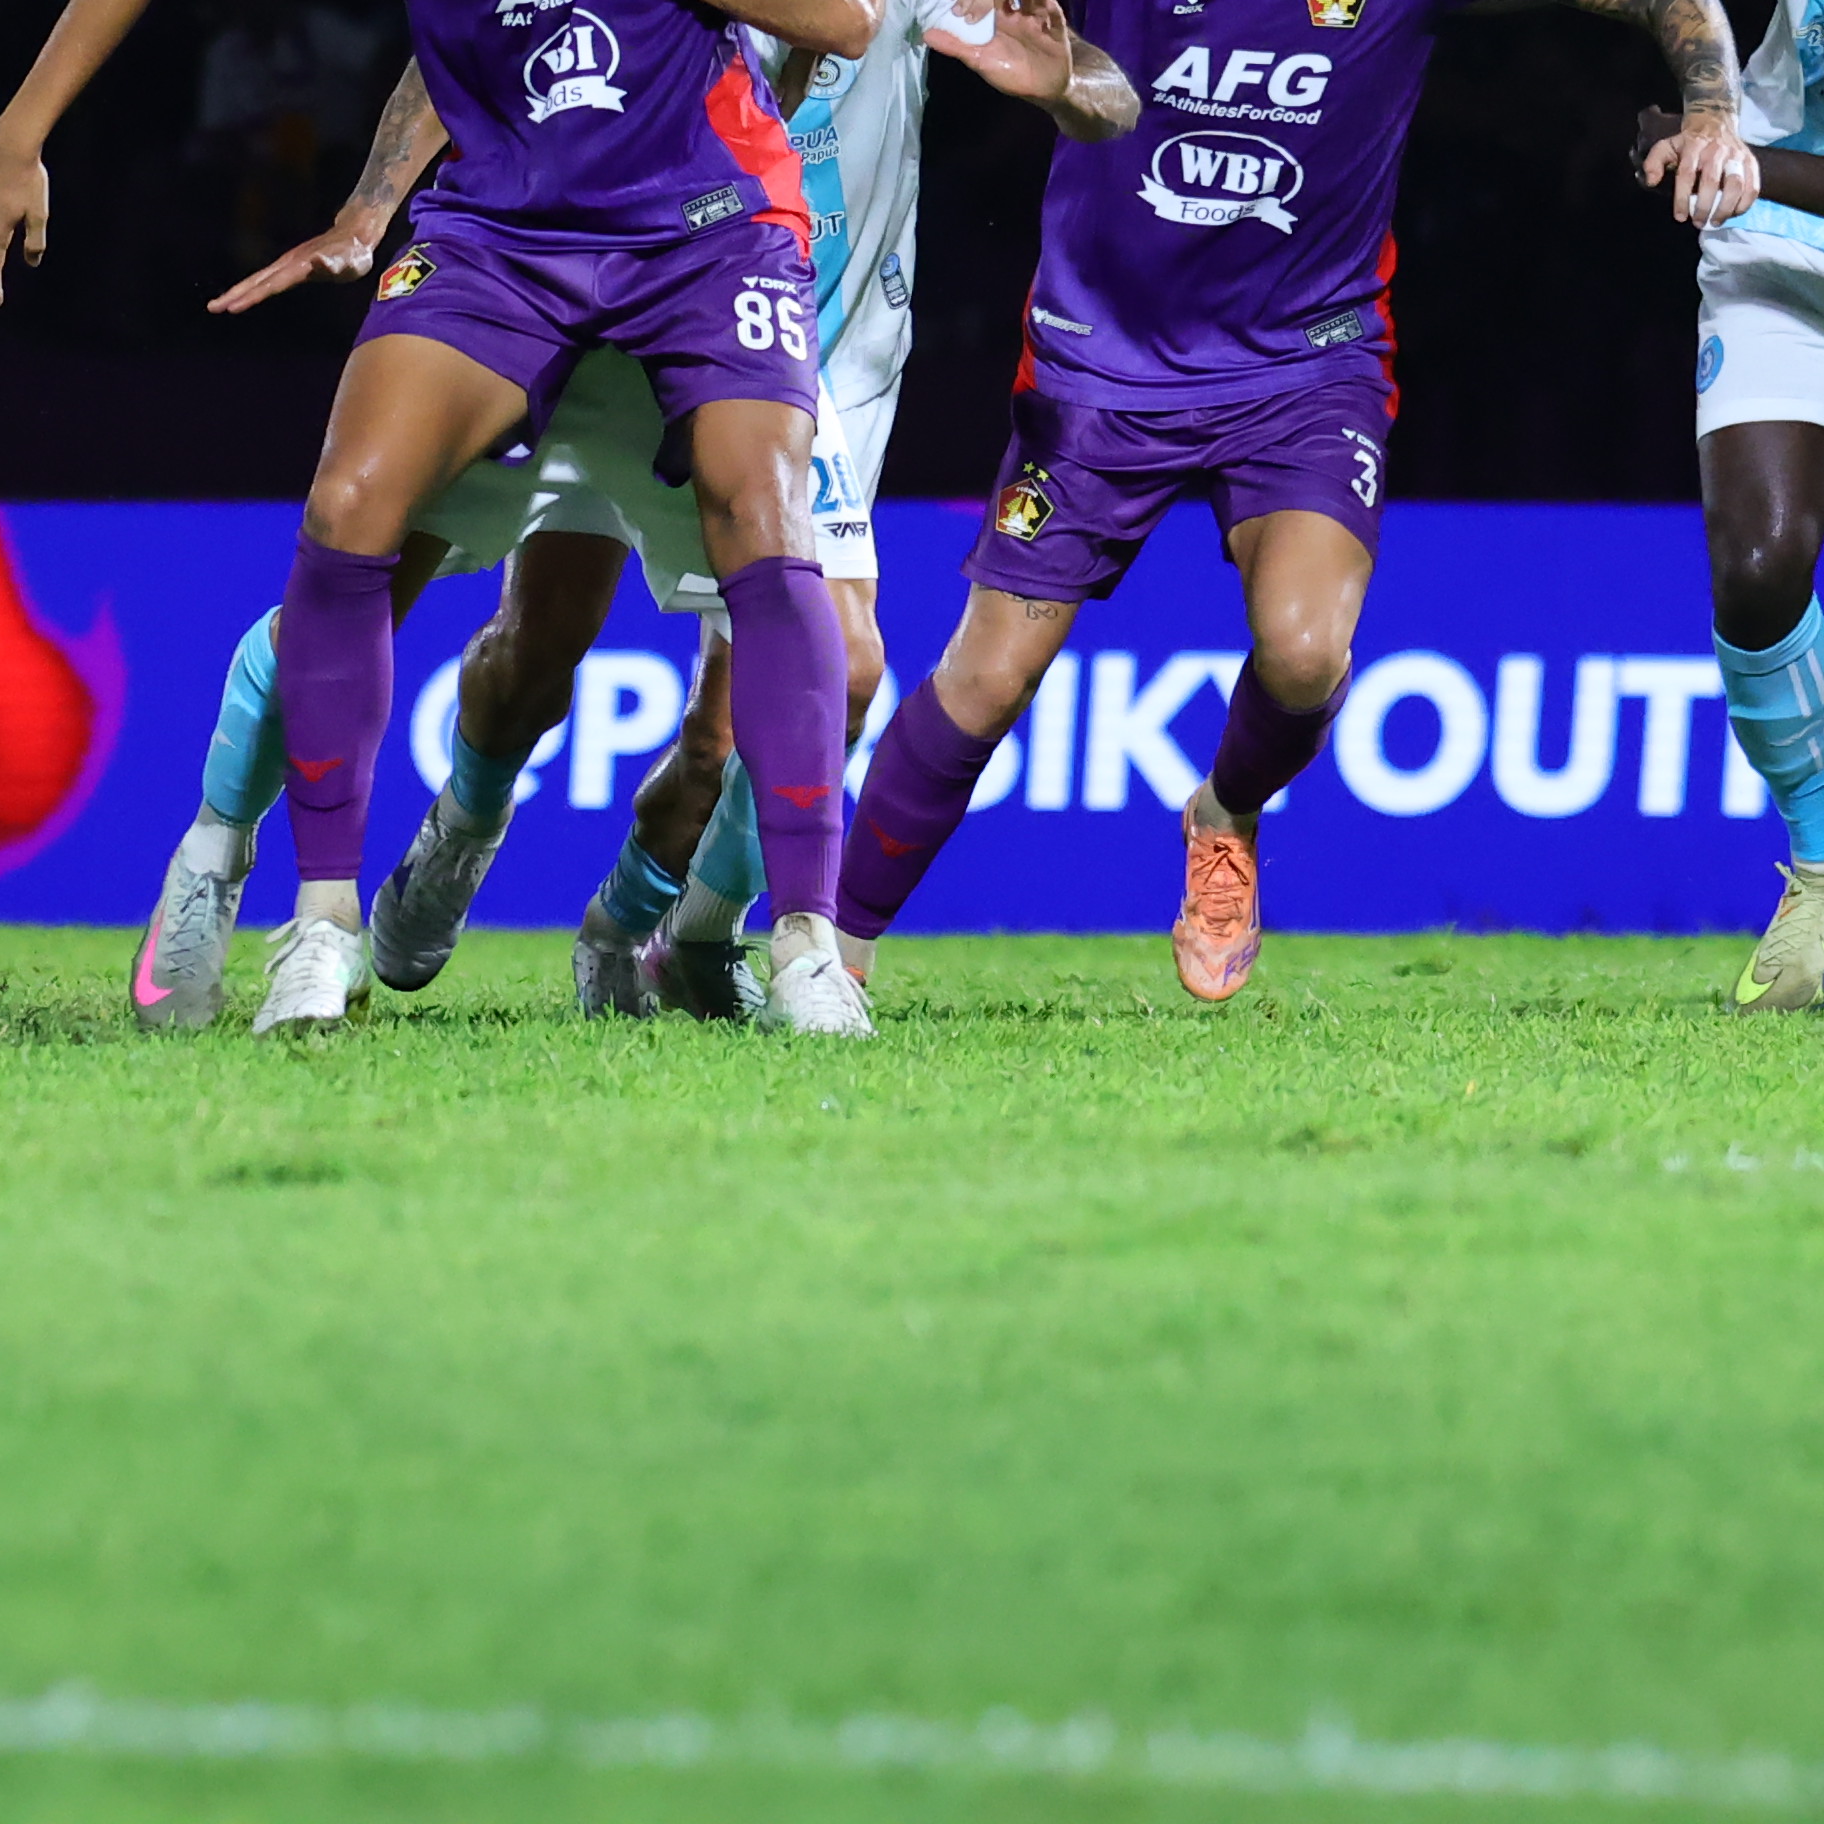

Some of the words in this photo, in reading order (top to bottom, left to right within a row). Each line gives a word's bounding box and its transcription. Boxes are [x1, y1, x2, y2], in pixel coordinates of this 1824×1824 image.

[1151, 46, 1332, 107] AFG
[1153, 92, 1322, 125] #AthletesForGood
[790, 126, 838, 150] PUA
[1179, 142, 1284, 194] WBI
[734, 291, 808, 362] 85
[1351, 449, 1377, 508] 3
